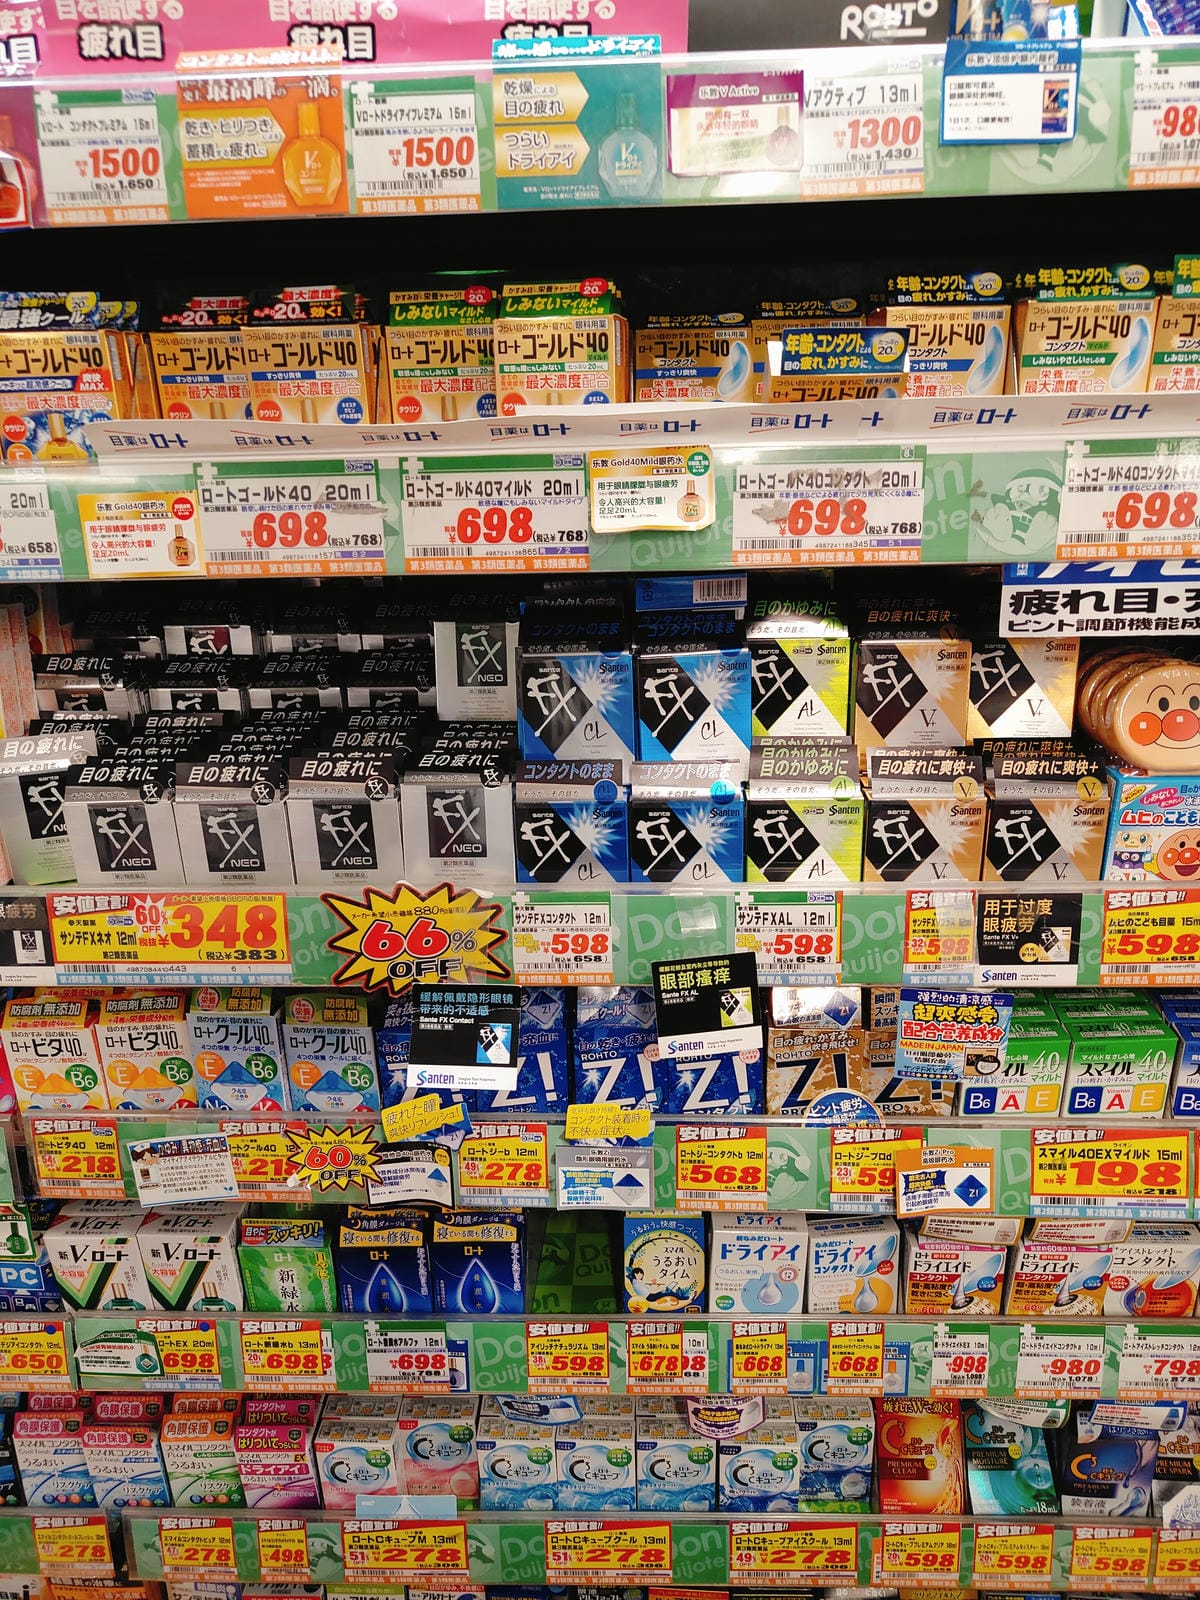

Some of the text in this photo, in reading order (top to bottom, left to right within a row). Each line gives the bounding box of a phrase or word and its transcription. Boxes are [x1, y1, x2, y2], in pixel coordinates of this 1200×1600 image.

[78, 24, 164, 59] 疲れ目
[730, 86, 759, 96] Active
[505, 100, 563, 116] 目の疲れ
[847, 116, 921, 148] 1300
[505, 133, 547, 147] つらい
[402, 136, 475, 168] 1500
[89, 148, 160, 178] 1500
[508, 153, 575, 169] ドライアイ
[505, 298, 599, 312] しみないマイルド
[394, 306, 484, 321] しみないマイルド
[276, 342, 356, 368] ゴールド40
[522, 332, 609, 365] ゴールド40
[658, 358, 697, 367] コンタクト
[655, 369, 698, 377] すっきり爽快
[279, 380, 360, 396] 最大濃度配合
[526, 373, 610, 390] 最大濃度配合
[1024, 379, 1106, 394] 最大濃度配合
[751, 413, 833, 429] 目薬は ロート
[933, 408, 1017, 424] 目薬は ロート
[490, 424, 571, 438] 目薬は ロート
[621, 420, 701, 432] 目薬は ロート
[739, 469, 917, 491] ロートゴールド40コンタクト 20ml
[202, 485, 371, 502] ロートゴールド40 20ml
[406, 479, 579, 498] ロートゴールド40マイルド 20ml
[10, 494, 44, 509] 20ml
[457, 507, 533, 543] 698
[787, 500, 867, 535] 698
[252, 512, 327, 548] 698
[411, 558, 587, 571] 第3類医薬品 第3類医薬品 第3類医薬品
[754, 600, 836, 616] 目のかゆみに
[526, 673, 577, 737] FX
[644, 673, 694, 737] FX
[79, 766, 155, 783] 目の疲れに
[188, 766, 269, 783] 目の疲れに
[302, 761, 379, 778] 目の疲れに
[525, 762, 614, 779] コンタクトのまま
[641, 762, 730, 779] コンタクトのまま
[760, 760, 848, 777] 目のかゆみに
[878, 760, 976, 777] 目の疲れに爽快+
[1001, 759, 1099, 775] 目の疲れに爽快+
[1142, 788, 1176, 804] しみない
[950, 805, 981, 817] Santen
[1073, 805, 1104, 816] Santen
[453, 844, 481, 853] NEO
[121, 857, 151, 868] NEO
[231, 858, 259, 868] NEO
[344, 857, 372, 867] NEO
[984, 899, 1053, 916] 用于过度
[515, 912, 607, 924] サンテFXコンタクト 12ml
[738, 911, 831, 926] サンテFXAL 12ml
[983, 917, 1034, 933] 眼疲劳
[142, 925, 161, 933] OFF
[171, 905, 277, 949] 348
[60, 931, 137, 946] サンテFXネオ 12ml
[361, 916, 477, 961] 66%
[551, 934, 609, 954] 598
[388, 956, 462, 980] OFF
[982, 969, 1017, 982] Santen
[660, 967, 731, 991] 眼部瘙痒
[420, 992, 514, 1004] 缓解佩戴隐形眼镜
[420, 1004, 490, 1016] 带来的不适感
[668, 1040, 704, 1054] Santen
[900, 1041, 925, 1049] MADE
[936, 1043, 963, 1051] JAPAN
[776, 1050, 812, 1060] ROHTO
[1084, 1062, 1135, 1076] スマイル
[1137, 1073, 1167, 1081] マイルド
[1001, 1094, 1020, 1110] A
[570, 1125, 631, 1136] 不快な症状に
[37, 1142, 115, 1150] ロートビタ40 12ml
[680, 1149, 763, 1159] ロートジーコンタクトb 12ml
[1039, 1148, 1182, 1161] スマイル40EXマイルド 15ml
[62, 1156, 116, 1173] 218
[485, 1163, 543, 1181] 278
[320, 1169, 362, 1181] OFF
[689, 1165, 762, 1185] 568
[266, 1223, 321, 1243] スッキリ!
[464, 1246, 484, 1255] ロート
[720, 1243, 800, 1261] ドライアイ
[814, 1244, 876, 1265] ドライアイ
[652, 1256, 697, 1267] うるおい
[814, 1264, 854, 1274] コンタクト
[913, 1261, 971, 1272] ドライエイド
[659, 1268, 690, 1279] タイム
[11, 1353, 62, 1369] 650
[163, 1352, 215, 1368] 698
[551, 1356, 605, 1371] 598
[639, 1356, 682, 1371] 678
[743, 1356, 782, 1371] 668
[951, 1356, 987, 1374] 998
[1050, 1359, 1100, 1375] 980
[19, 1419, 61, 1433] 角膜保護
[22, 1458, 64, 1468] うるおい
[972, 1451, 1007, 1460] PREMIUM
[972, 1457, 1008, 1466] MOISTURE
[241, 1465, 304, 1475] ドライアイ
[887, 1460, 922, 1470] PREMIUM
[892, 1467, 917, 1475] CLEAR
[352, 1535, 457, 1544] ロートCキューブM 13ml
[551, 1534, 666, 1545] ロートCキューブクール 13ml
[735, 1535, 852, 1546] ロートCキューブアイスクール 13ml
[59, 1544, 106, 1558] 278
[269, 1548, 304, 1562] 498
[904, 1553, 956, 1567] 598
